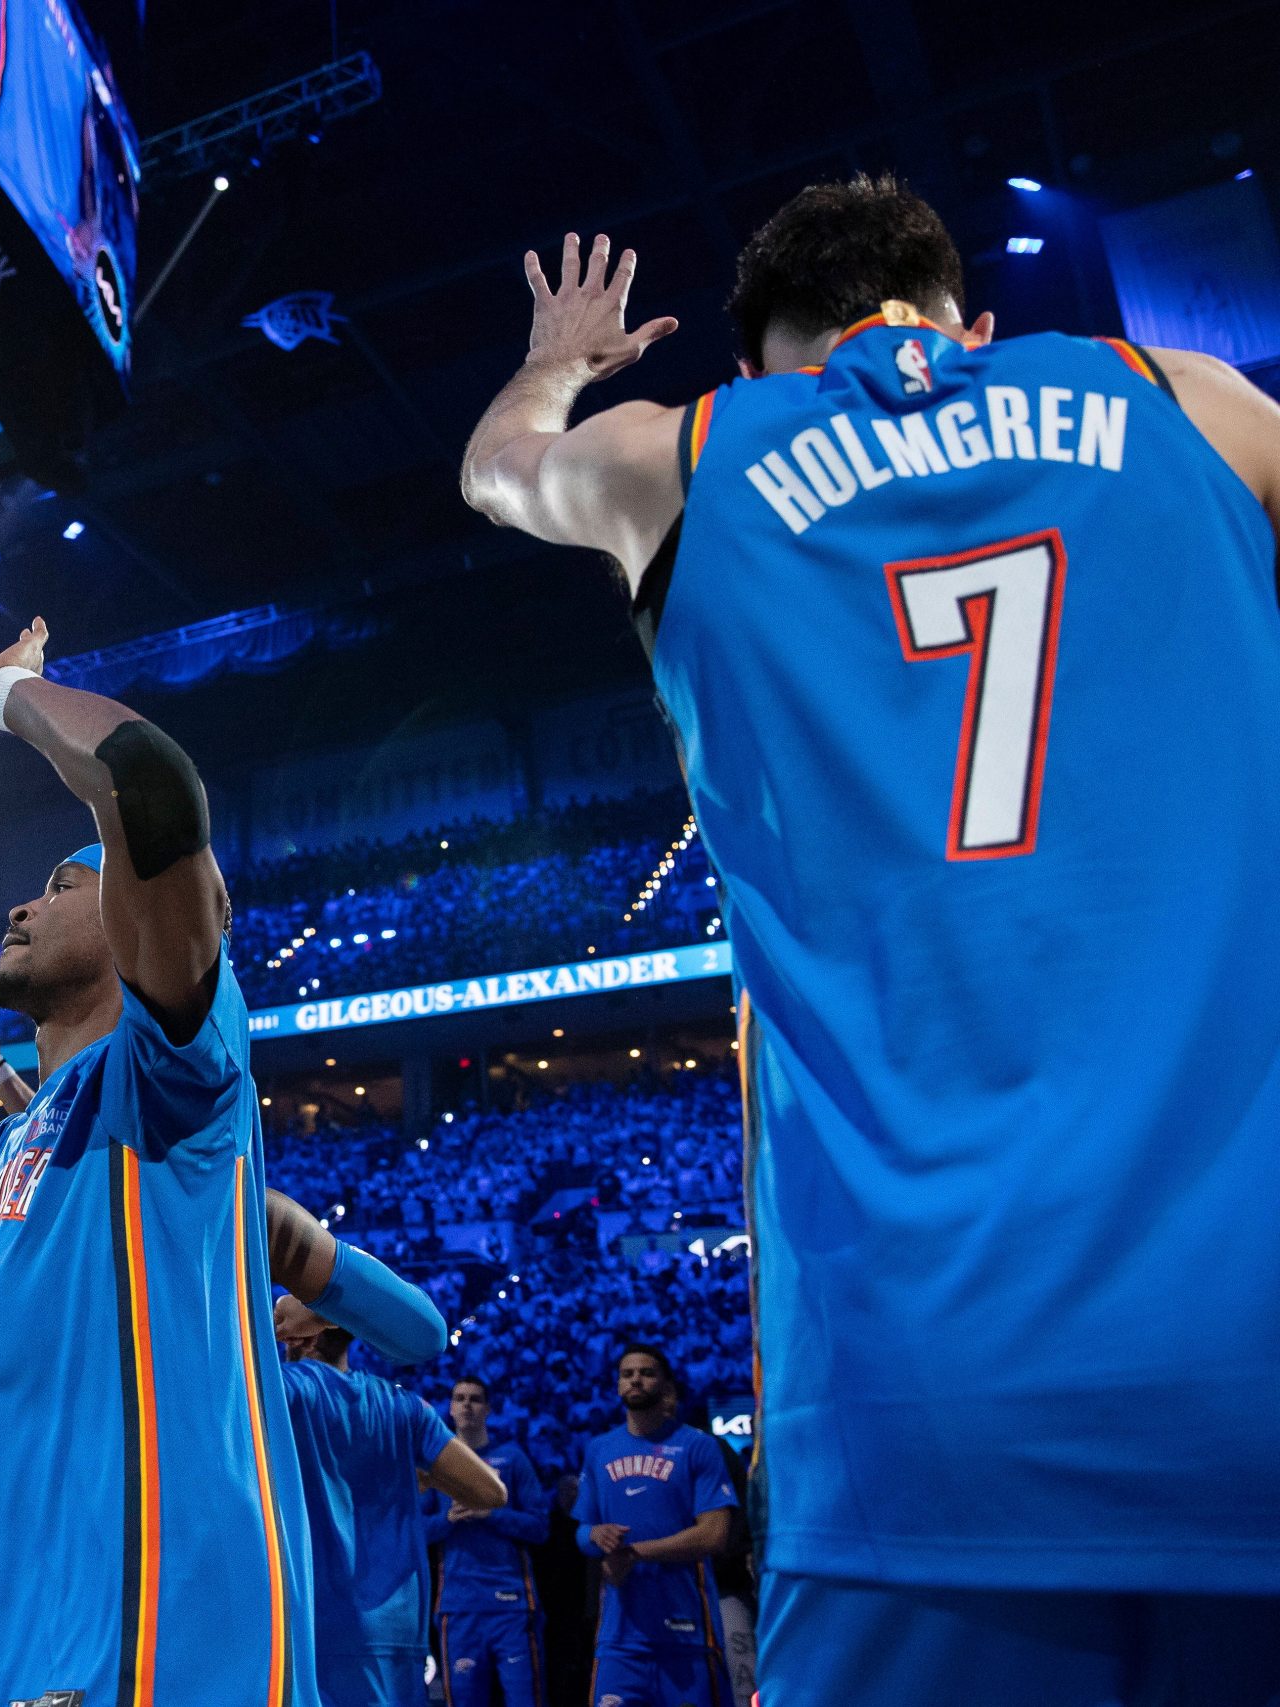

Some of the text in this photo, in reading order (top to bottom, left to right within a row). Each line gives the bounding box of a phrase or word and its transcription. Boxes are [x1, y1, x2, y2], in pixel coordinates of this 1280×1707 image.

[744, 384, 1128, 536] HOLMGREN
[883, 526, 1068, 863] 7
[295, 948, 718, 1033] GILGEOUS-ALEXANDER 2
[605, 1455, 674, 1482] THUNDER
